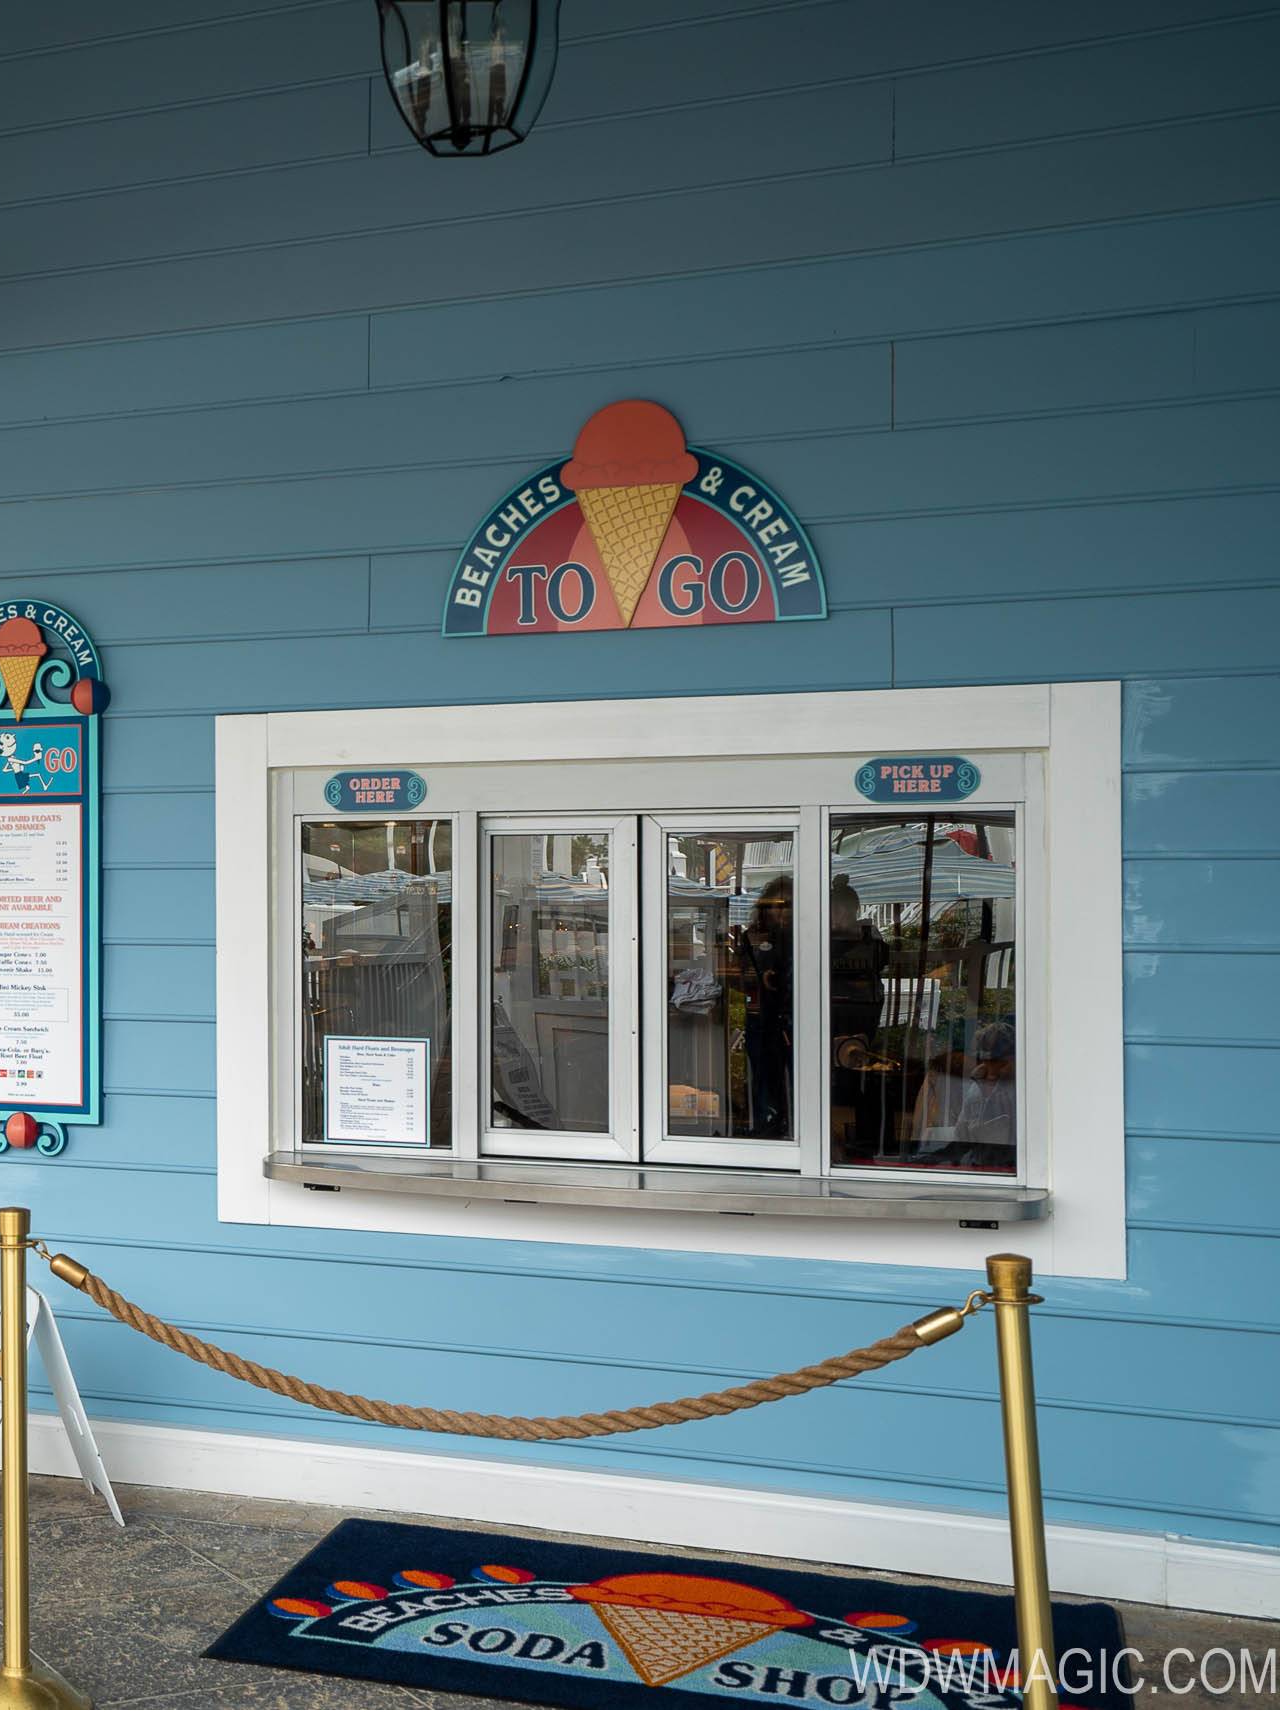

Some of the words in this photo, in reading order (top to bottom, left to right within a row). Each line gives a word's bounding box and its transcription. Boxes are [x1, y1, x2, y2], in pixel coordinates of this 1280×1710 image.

[455, 475, 562, 608] BEACHES
[699, 466, 724, 496] &
[728, 485, 812, 590] CREAM
[506, 562, 597, 626] TO
[657, 550, 762, 618] GO
[24, 604, 38, 619] &
[42, 609, 94, 667] CREAM
[44, 747, 78, 773] GO
[880, 765, 924, 779] PICK
[929, 764, 954, 778] UP
[349, 777, 401, 791] ORDER
[893, 779, 941, 793] HERE
[355, 790, 395, 804] HERE
[31, 814, 62, 822] FLOATS
[15, 823, 46, 831] SHAKES
[24, 895, 44, 903] BEER
[45, 895, 63, 903] AND
[21, 922, 61, 930] CREATIONS
[338, 1586, 576, 1632] BEACHES
[819, 1628, 868, 1645] &
[422, 1620, 610, 1671] SODA
[713, 1660, 916, 1710] SHOP
